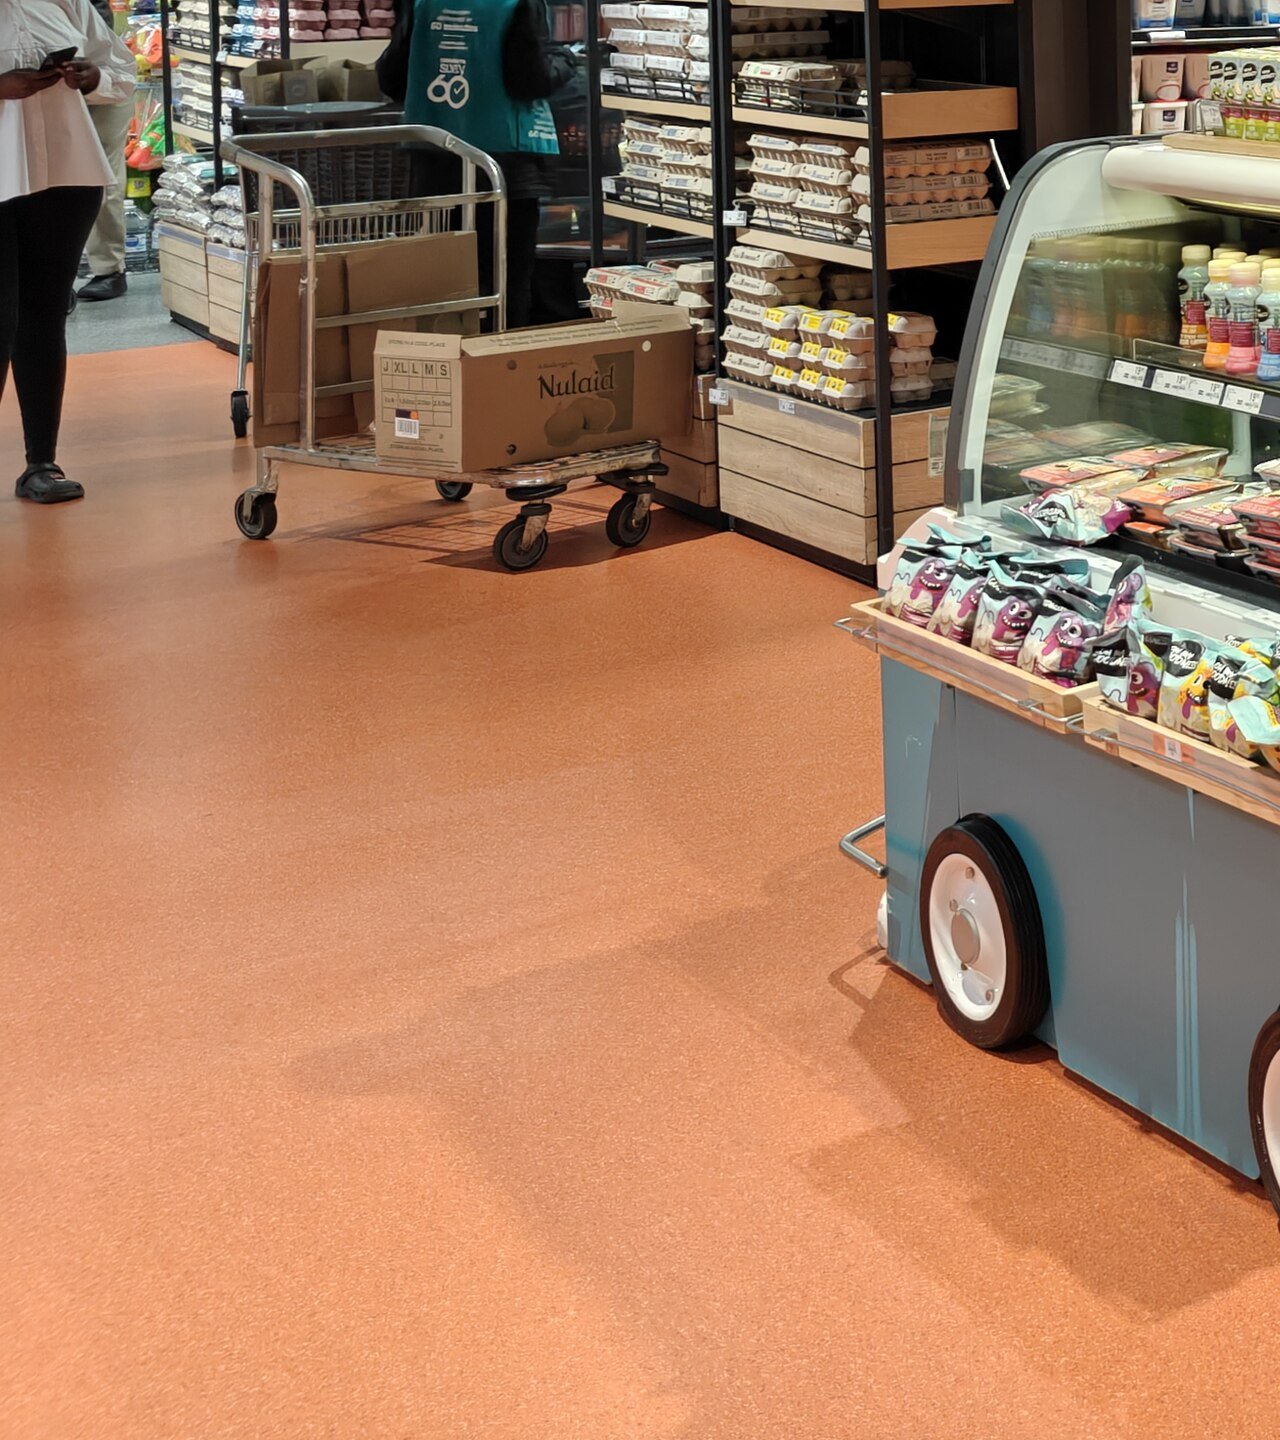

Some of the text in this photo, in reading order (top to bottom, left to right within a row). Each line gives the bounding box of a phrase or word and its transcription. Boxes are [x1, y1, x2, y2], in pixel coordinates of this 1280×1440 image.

[383, 362, 447, 376] J XL L M S
[538, 365, 615, 399] Nulaid
